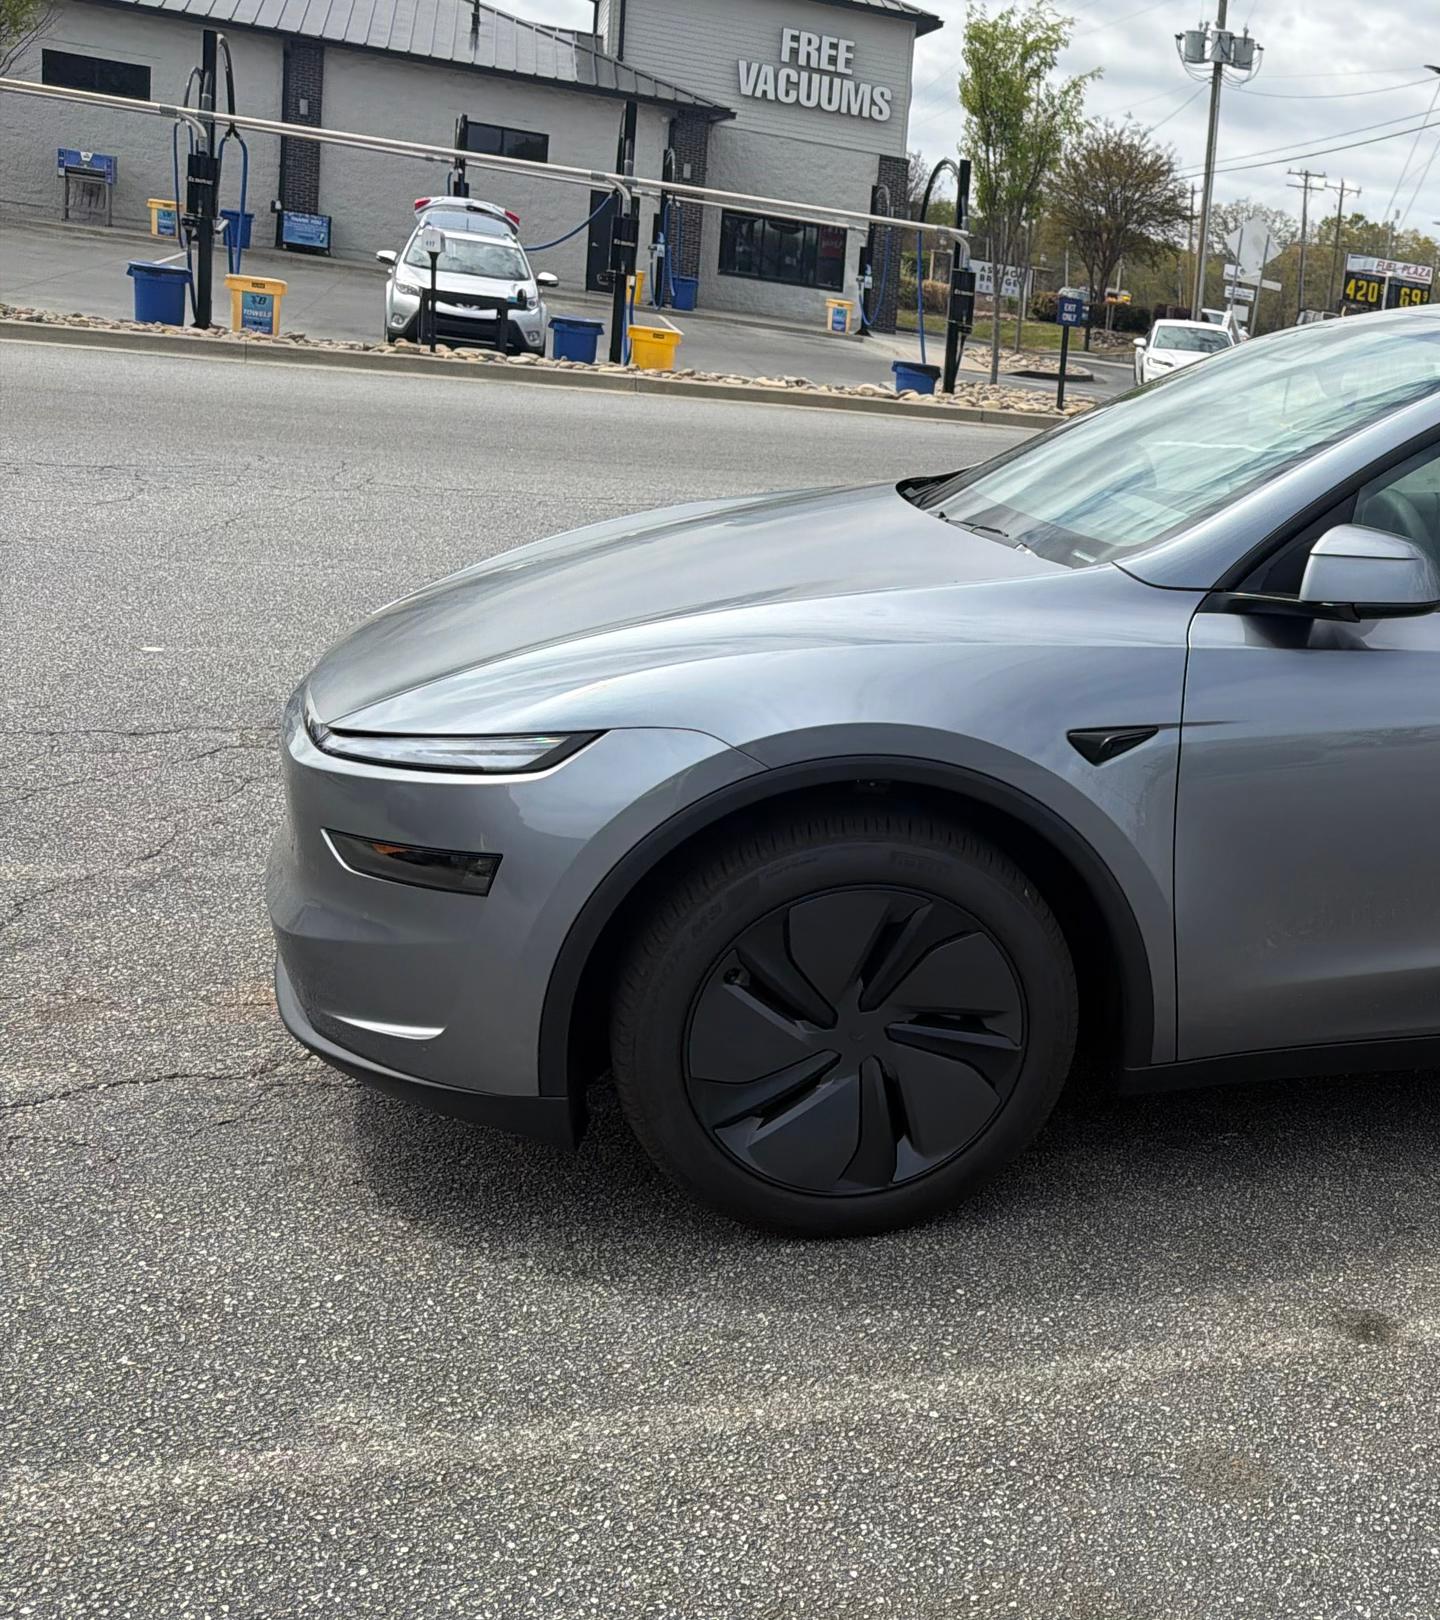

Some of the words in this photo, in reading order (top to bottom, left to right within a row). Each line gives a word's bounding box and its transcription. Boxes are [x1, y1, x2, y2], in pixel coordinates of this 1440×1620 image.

[780, 27, 856, 75] FREE
[738, 59, 893, 122] VACUUMS
[1401, 264, 1431, 277] PLAZA
[1346, 278, 1379, 303] 420
[1062, 312, 1077, 322] ONLY
[1064, 303, 1077, 312] EXIT
